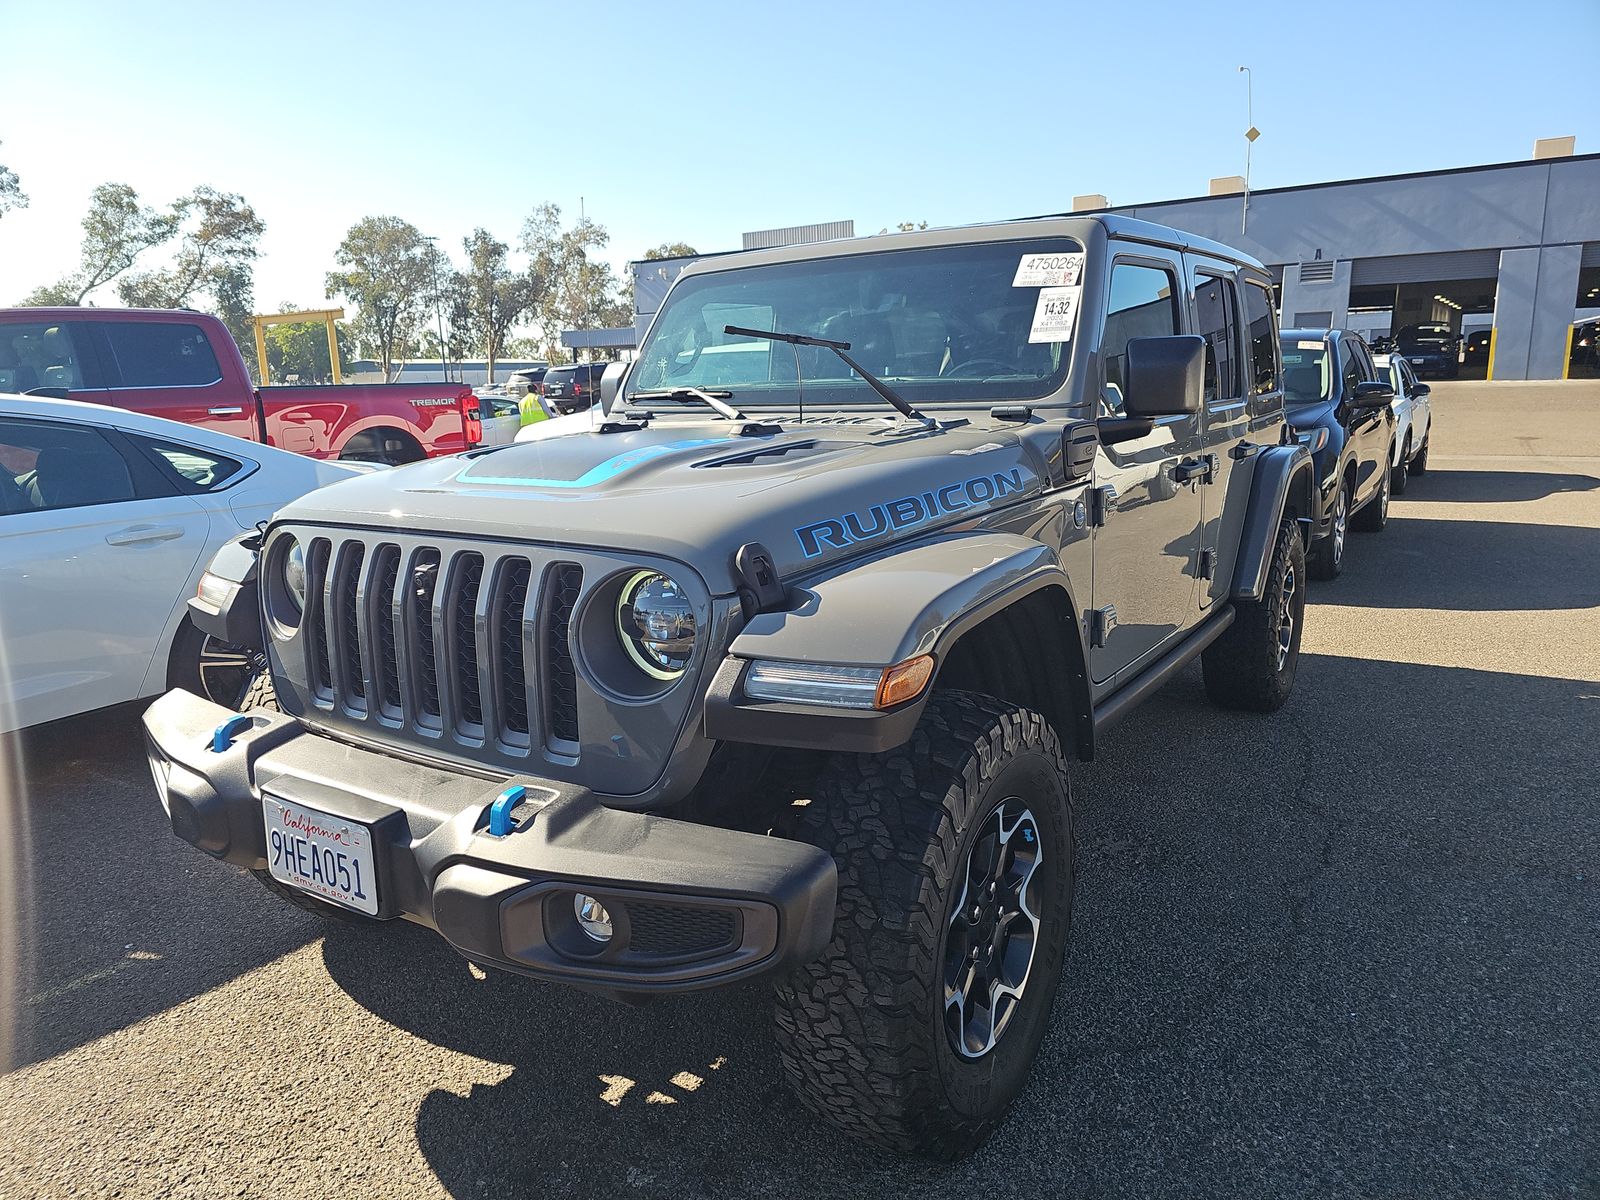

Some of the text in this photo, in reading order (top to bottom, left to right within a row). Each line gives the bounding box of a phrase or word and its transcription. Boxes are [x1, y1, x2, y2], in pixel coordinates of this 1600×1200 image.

[1027, 257, 1083, 270] 4750264
[1314, 248, 1322, 260] A
[1045, 302, 1070, 315] 14:32
[409, 398, 456, 407] TREMOR
[794, 467, 1025, 559] RUBICON
[283, 809, 350, 847] California
[271, 829, 366, 901] 9HEA051
[293, 875, 349, 901] dmv.ca.gov
